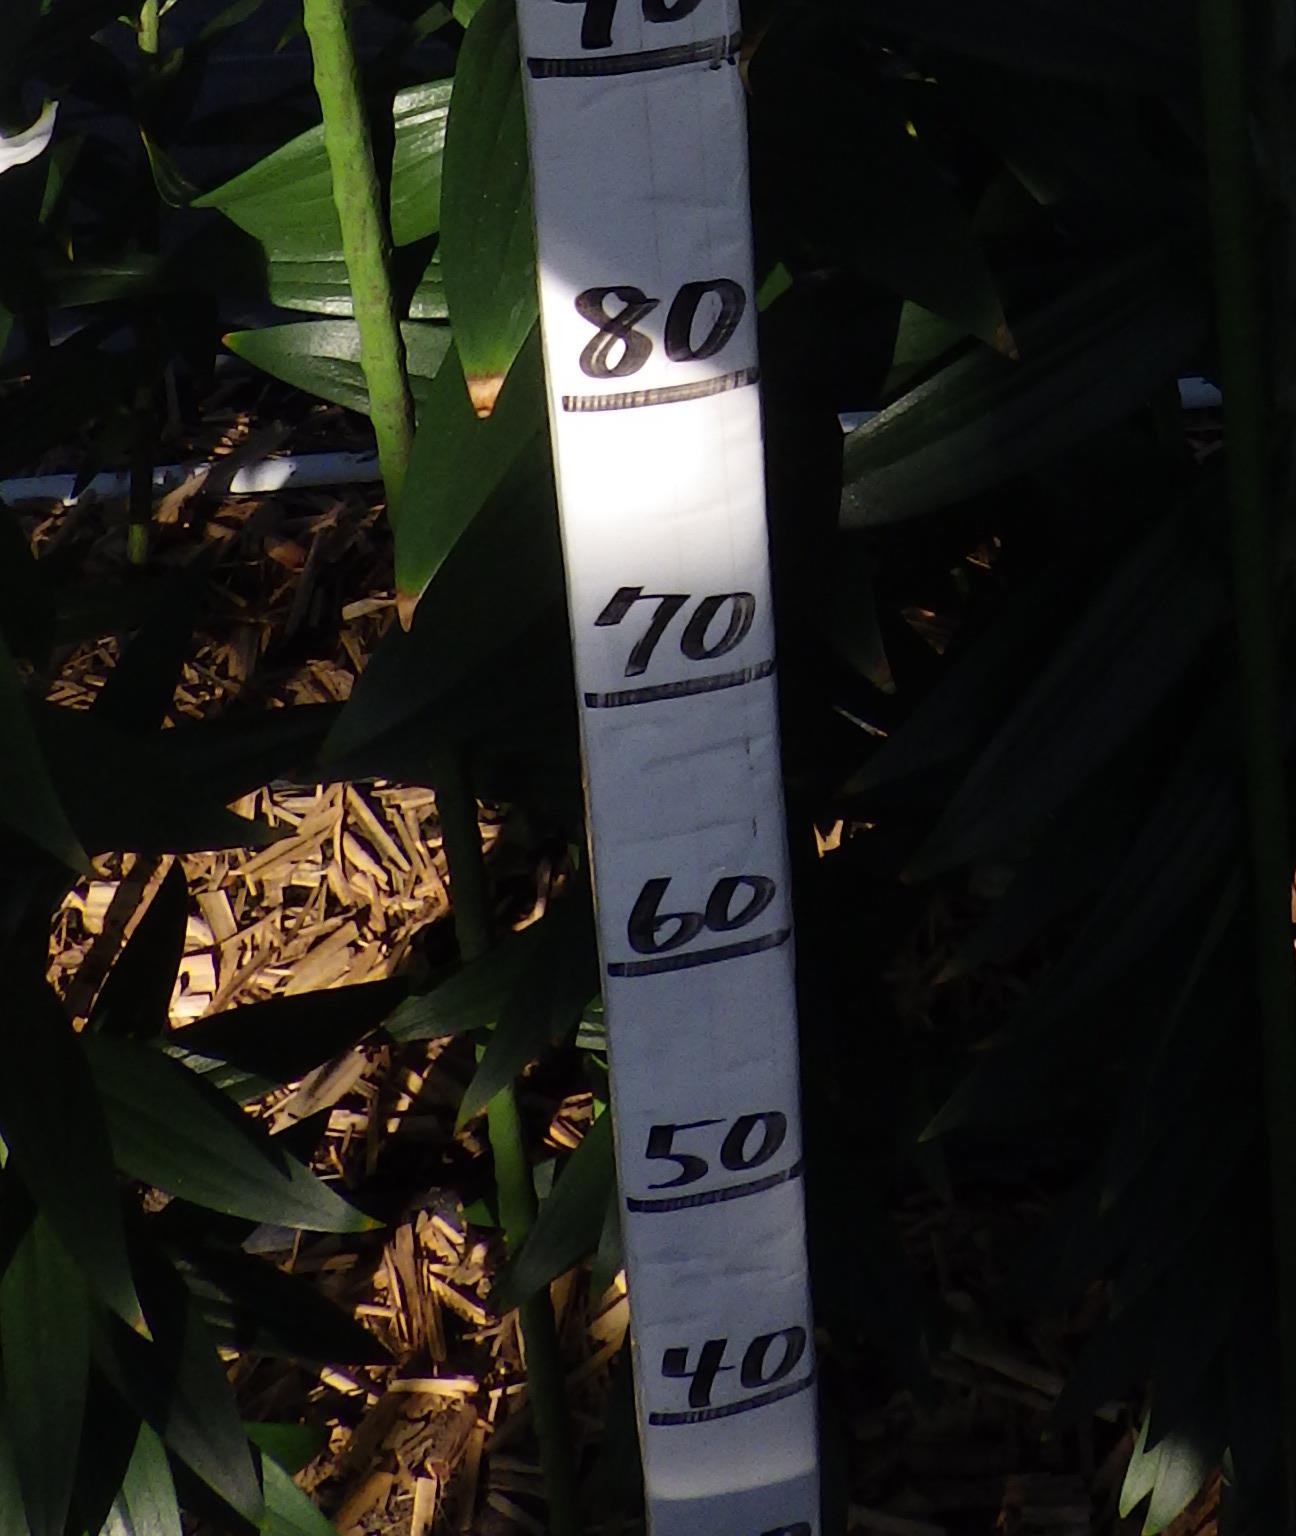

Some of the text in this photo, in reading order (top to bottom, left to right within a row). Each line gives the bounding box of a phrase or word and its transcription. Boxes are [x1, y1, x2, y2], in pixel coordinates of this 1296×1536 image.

[575, 277, 747, 379] 80
[594, 586, 756, 677] 70
[627, 873, 777, 955] 60
[645, 1109, 787, 1188] 50
[662, 1326, 806, 1408] 40
